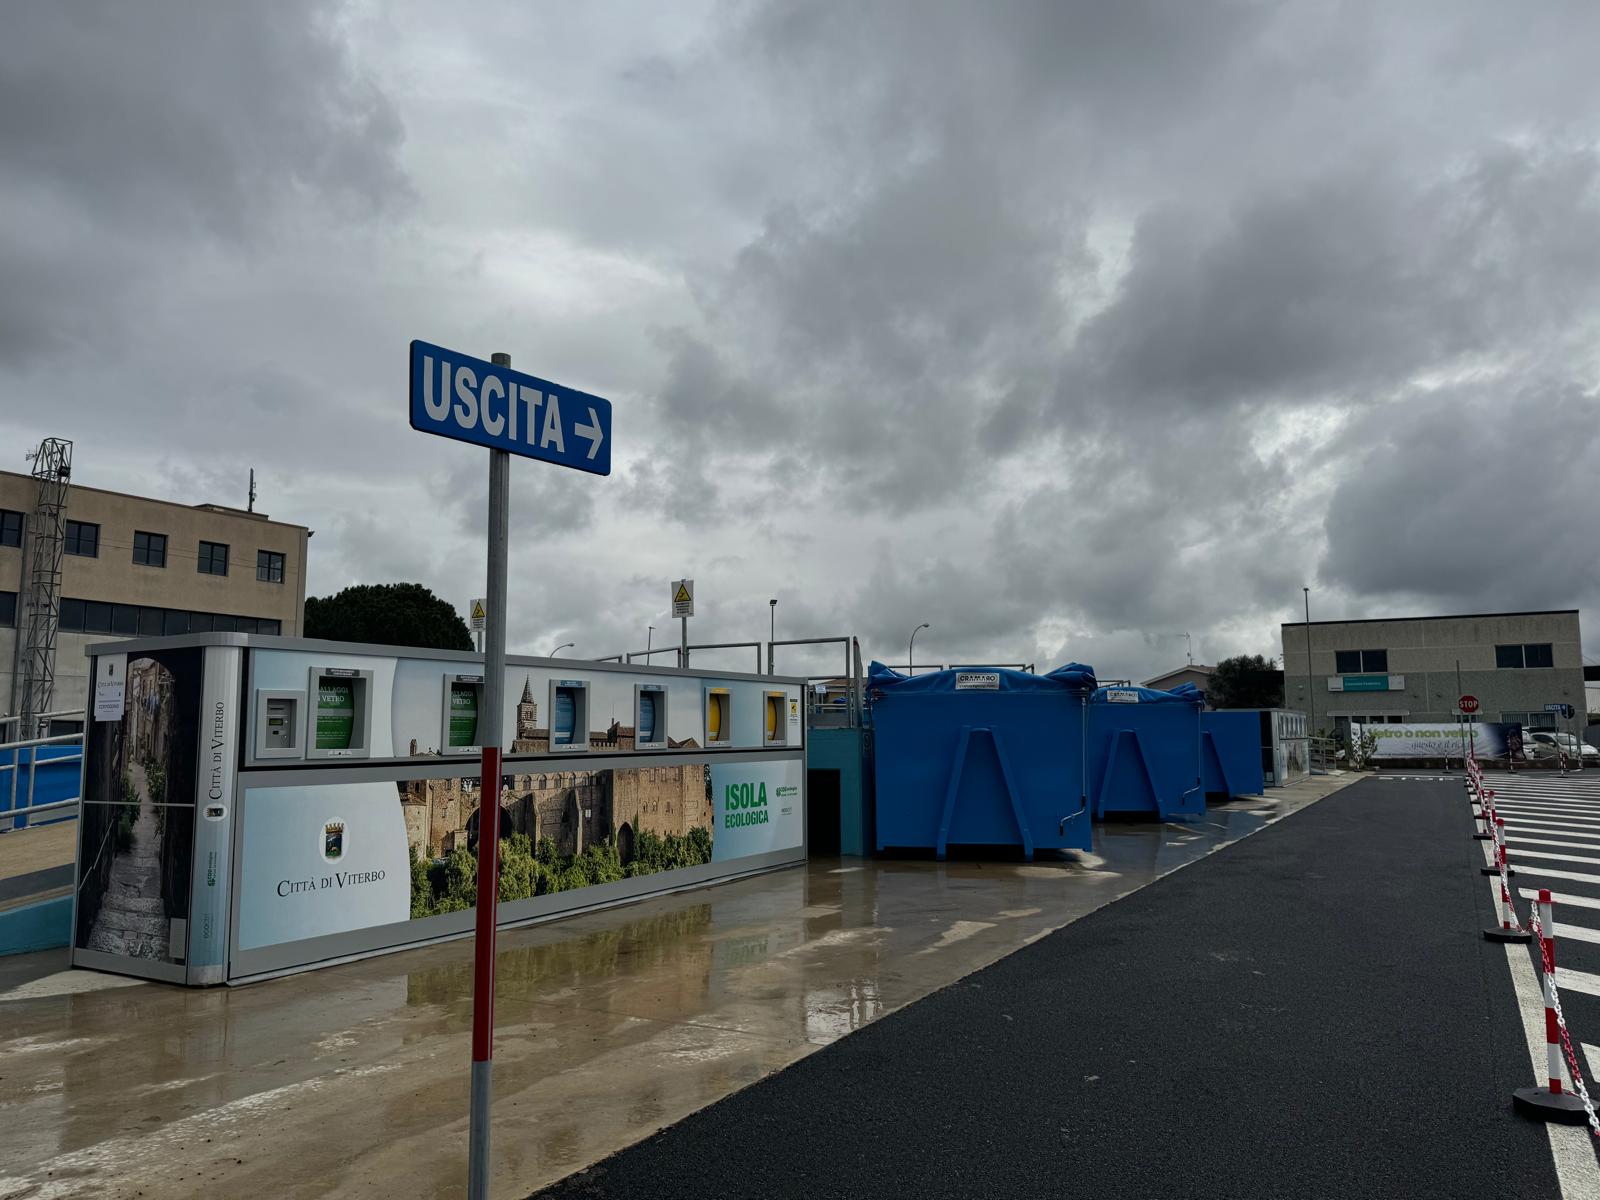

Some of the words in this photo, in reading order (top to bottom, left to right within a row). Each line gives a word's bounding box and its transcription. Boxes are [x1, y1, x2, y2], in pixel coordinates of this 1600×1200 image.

[423, 355, 566, 453] USCITA
[321, 695, 345, 703] VETRO
[1459, 700, 1478, 709] STOP
[211, 701, 225, 750] VITERBO
[1404, 730, 1413, 738] o
[1415, 730, 1440, 738] non
[1442, 728, 1479, 738] vetro
[213, 752, 222, 763] DI
[208, 766, 223, 800] CITTÀ
[725, 781, 768, 811] ISOLA
[725, 810, 769, 829] ECOLOGICA
[276, 877, 316, 897] CITTÀ
[320, 876, 332, 889] DI
[335, 870, 386, 889] VITERBO
